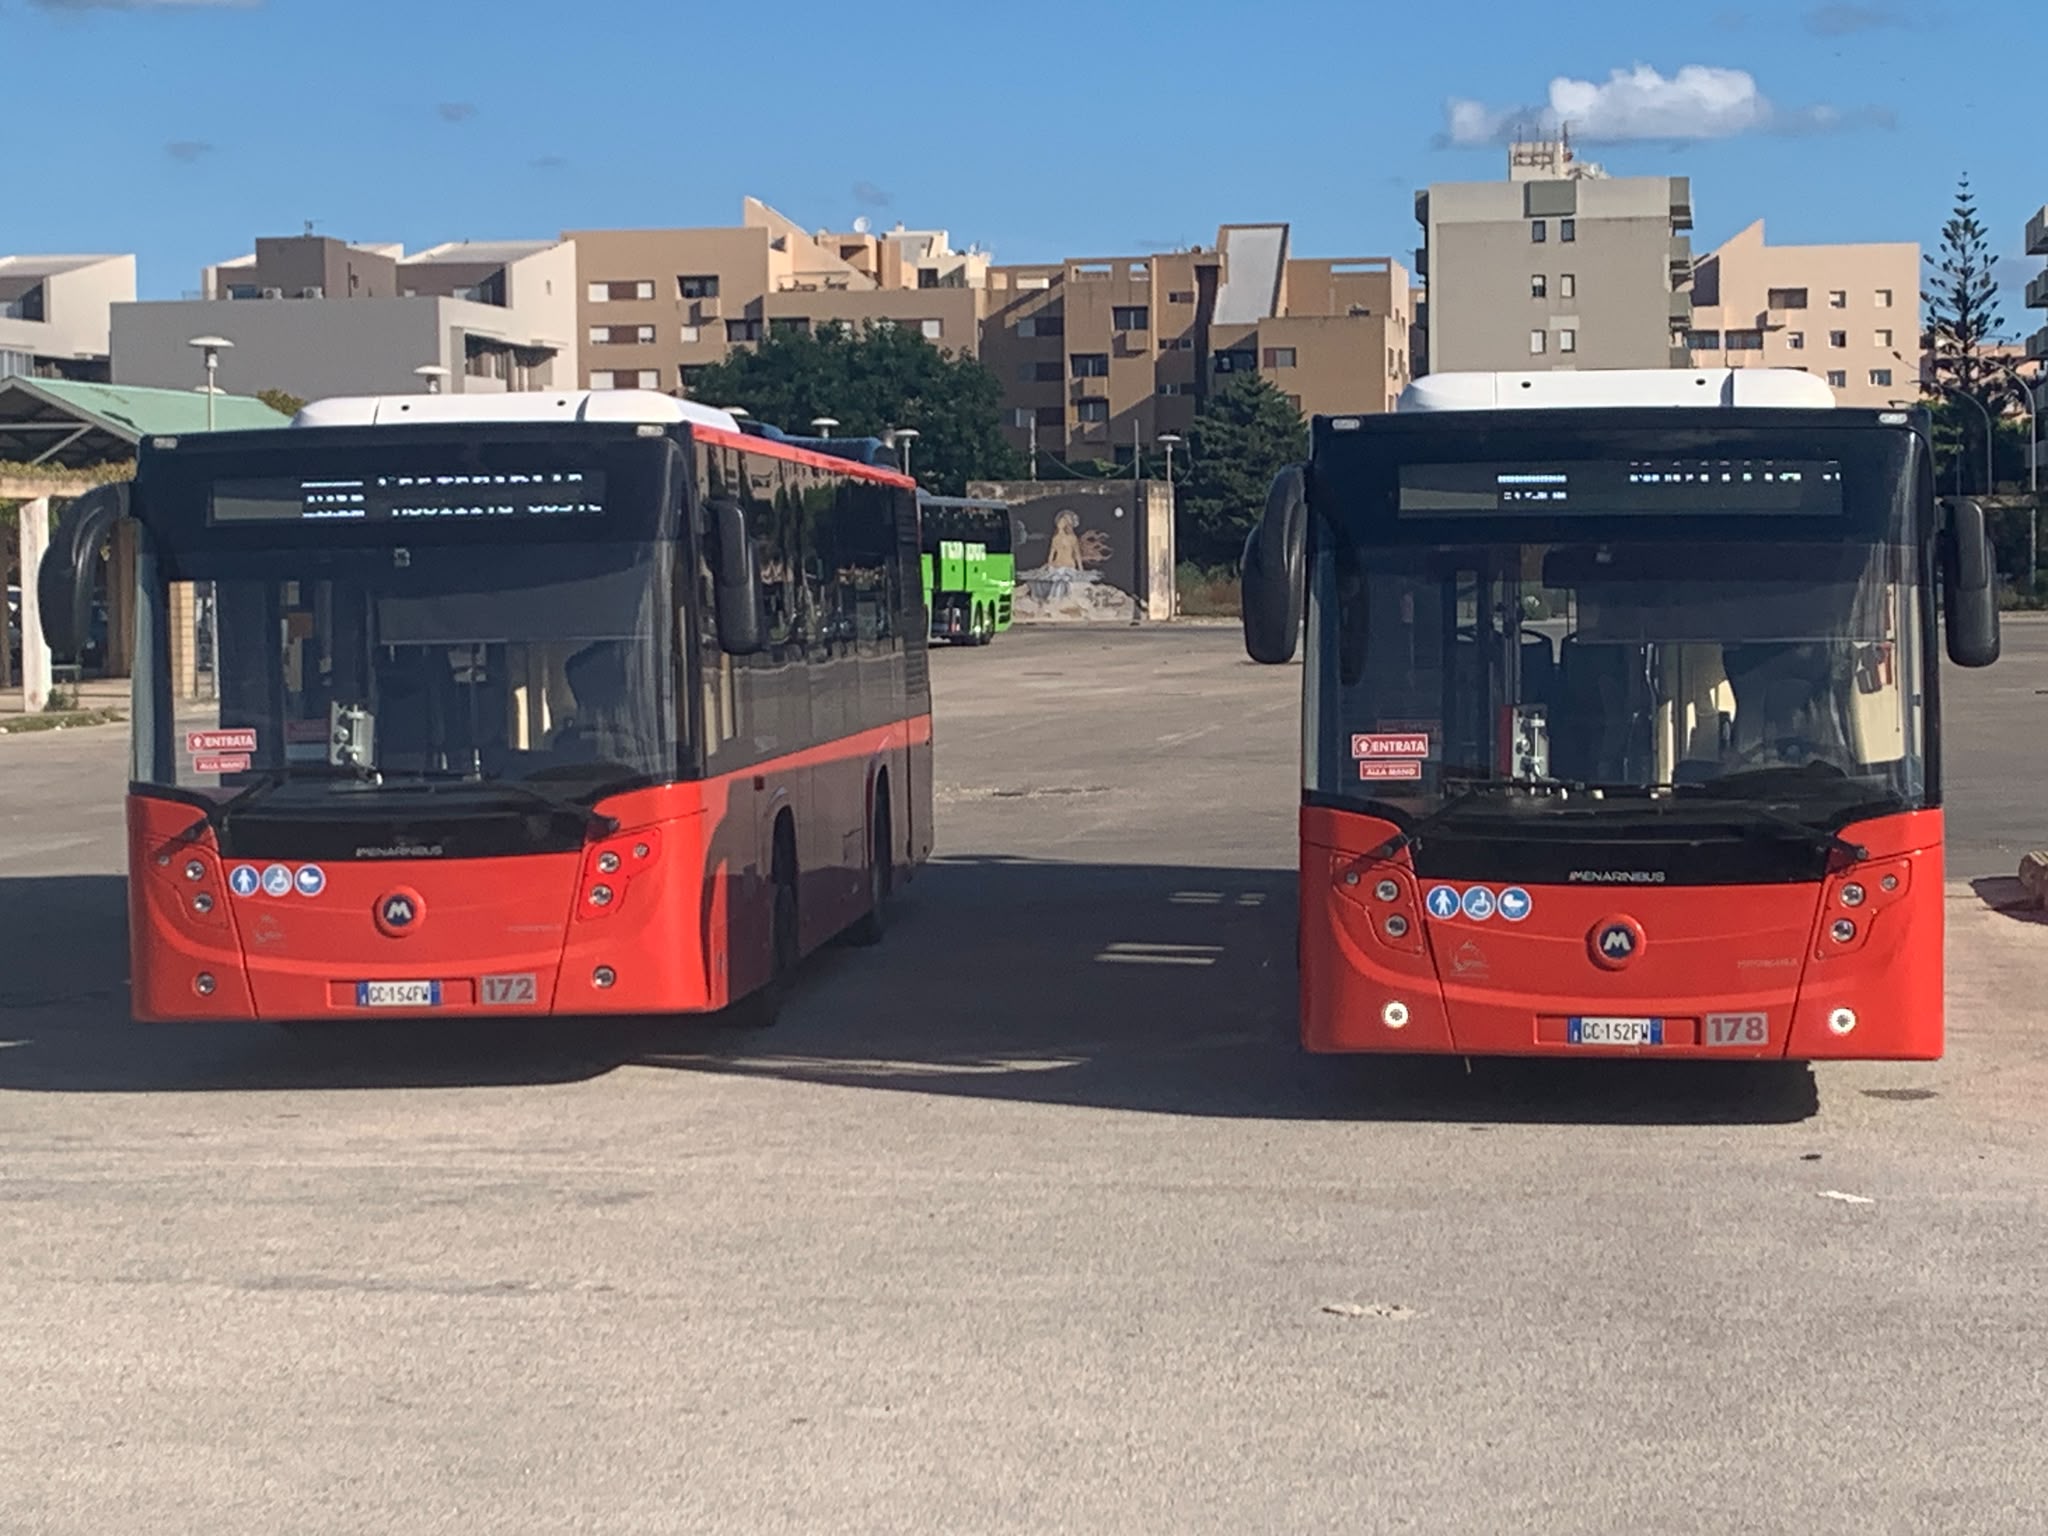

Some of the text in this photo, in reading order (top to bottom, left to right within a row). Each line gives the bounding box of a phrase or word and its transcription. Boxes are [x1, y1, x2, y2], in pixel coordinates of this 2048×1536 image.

[204, 735, 254, 748] ENTRATA
[1372, 740, 1425, 753] ENTRATA
[1365, 767, 1387, 776] ALLA
[386, 901, 412, 920] M
[1603, 931, 1632, 951] M
[484, 977, 533, 1002] 172
[1710, 1016, 1765, 1043] 178
